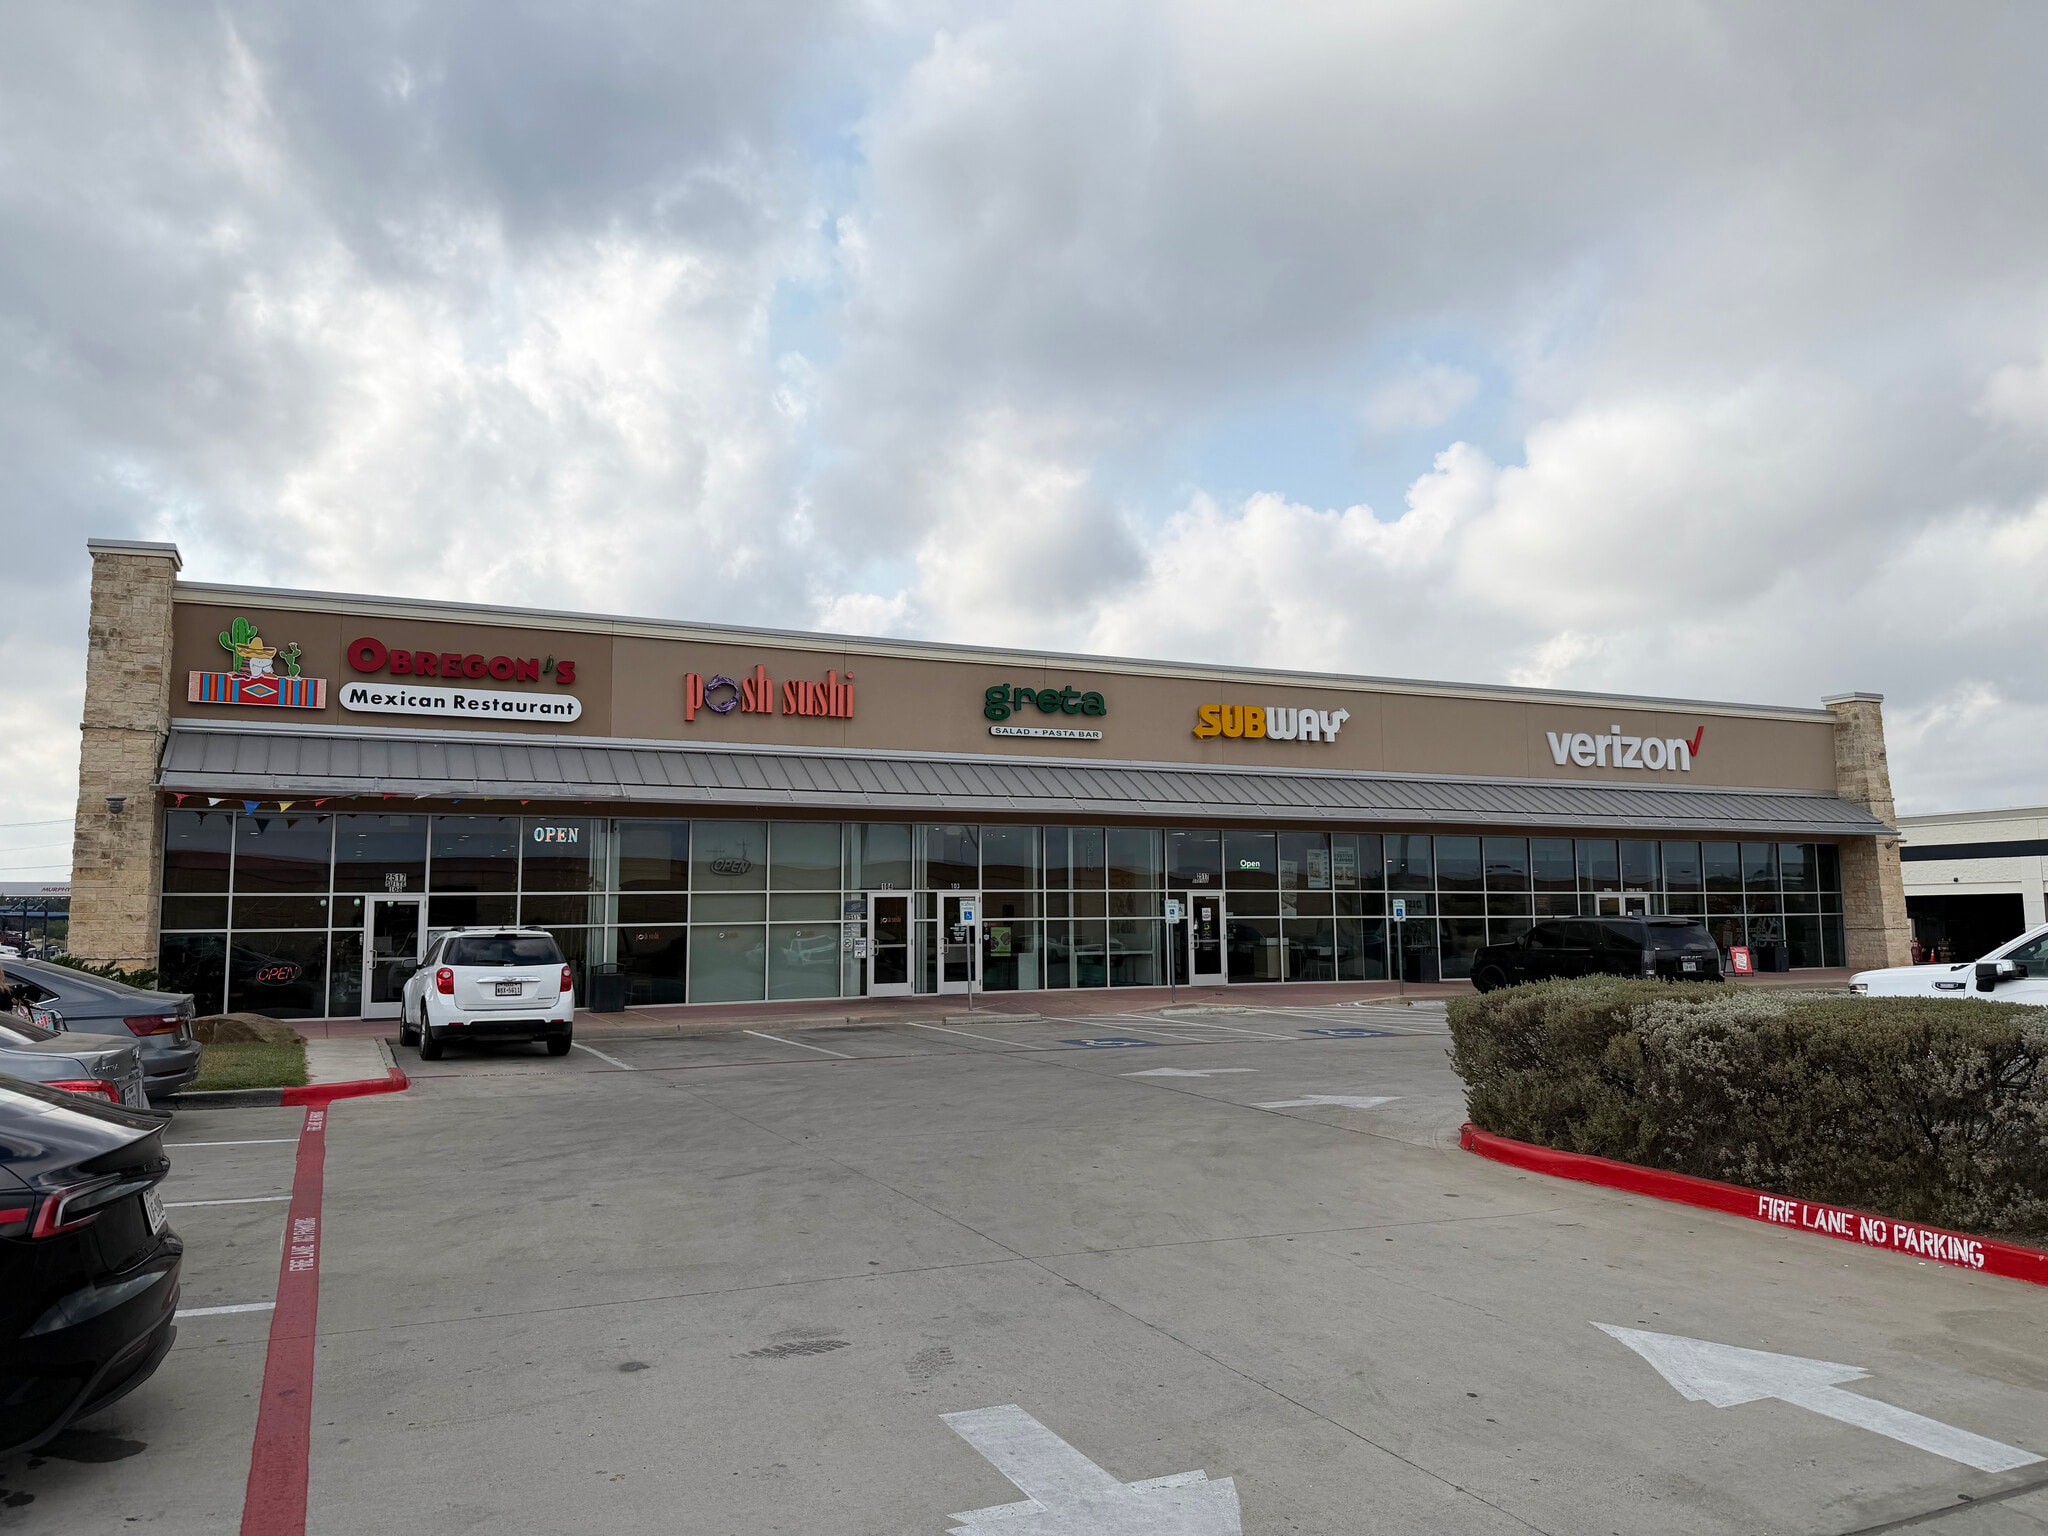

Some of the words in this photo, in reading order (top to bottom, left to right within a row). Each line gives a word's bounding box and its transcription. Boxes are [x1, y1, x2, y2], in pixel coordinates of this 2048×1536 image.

[347, 637, 576, 684] OBREGON'S
[349, 688, 446, 709] Mexican
[453, 695, 574, 716] Restaurant
[684, 664, 774, 721] posh
[782, 669, 854, 718] sushi
[984, 683, 1107, 720] greta
[995, 727, 1030, 735] SALAD
[1042, 729, 1075, 737] PASTA
[1193, 703, 1350, 742] SUBWAY
[1547, 724, 1691, 771] verizon
[533, 827, 579, 843] OPEN
[385, 872, 407, 881] 2517
[714, 860, 748, 873] OPEN
[1240, 859, 1260, 869] Open
[258, 966, 298, 981] OPEN
[1758, 1195, 1797, 1225] FIRE
[1802, 1204, 1854, 1236] LANE
[1859, 1217, 1887, 1243] NO
[1893, 1224, 1985, 1268] PARKING
